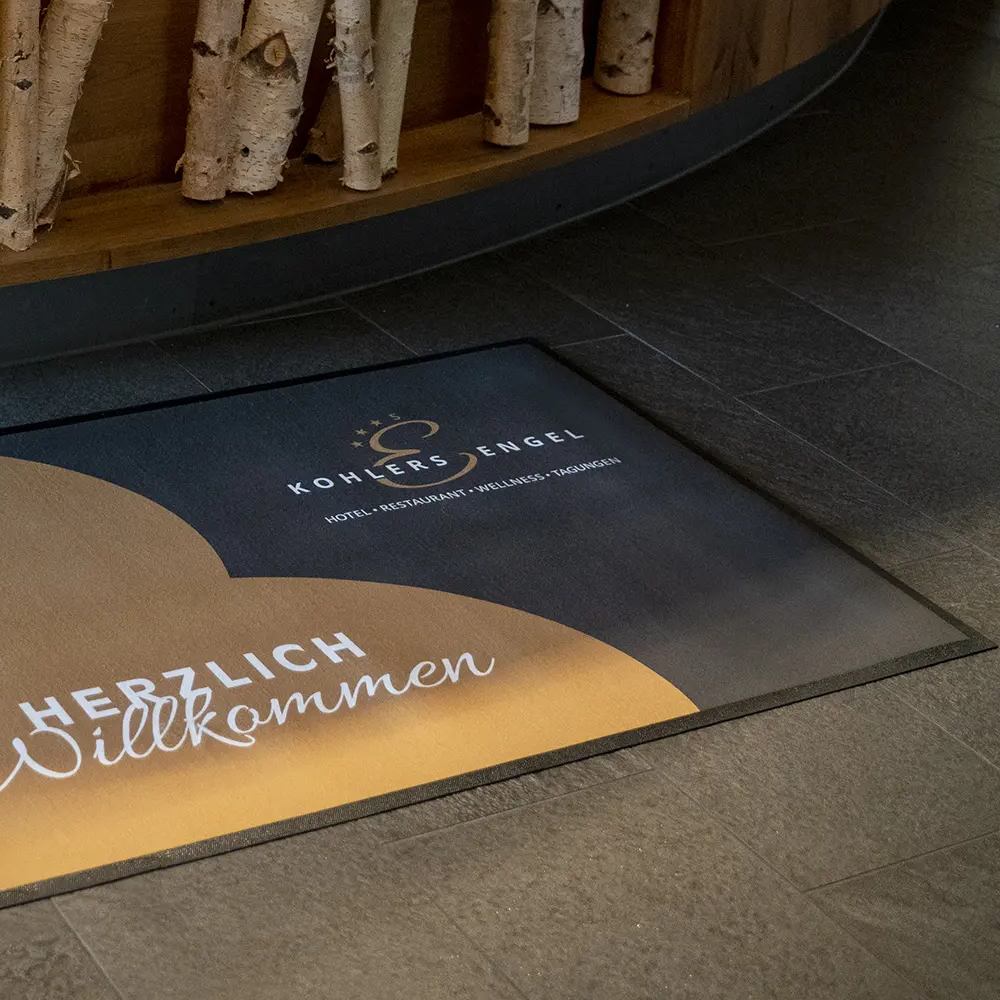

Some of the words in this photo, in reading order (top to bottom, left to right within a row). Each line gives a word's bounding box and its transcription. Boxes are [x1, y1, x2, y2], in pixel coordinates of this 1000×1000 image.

[287, 455, 448, 495] KOHLERS
[476, 429, 584, 457] ENGEL
[325, 508, 372, 524] HOTEL
[379, 488, 467, 513] RESTAURANT
[474, 473, 545, 493] WELLNESS
[550, 456, 621, 478] TAGUNGEN
[18, 632, 367, 732] HERZLICH
